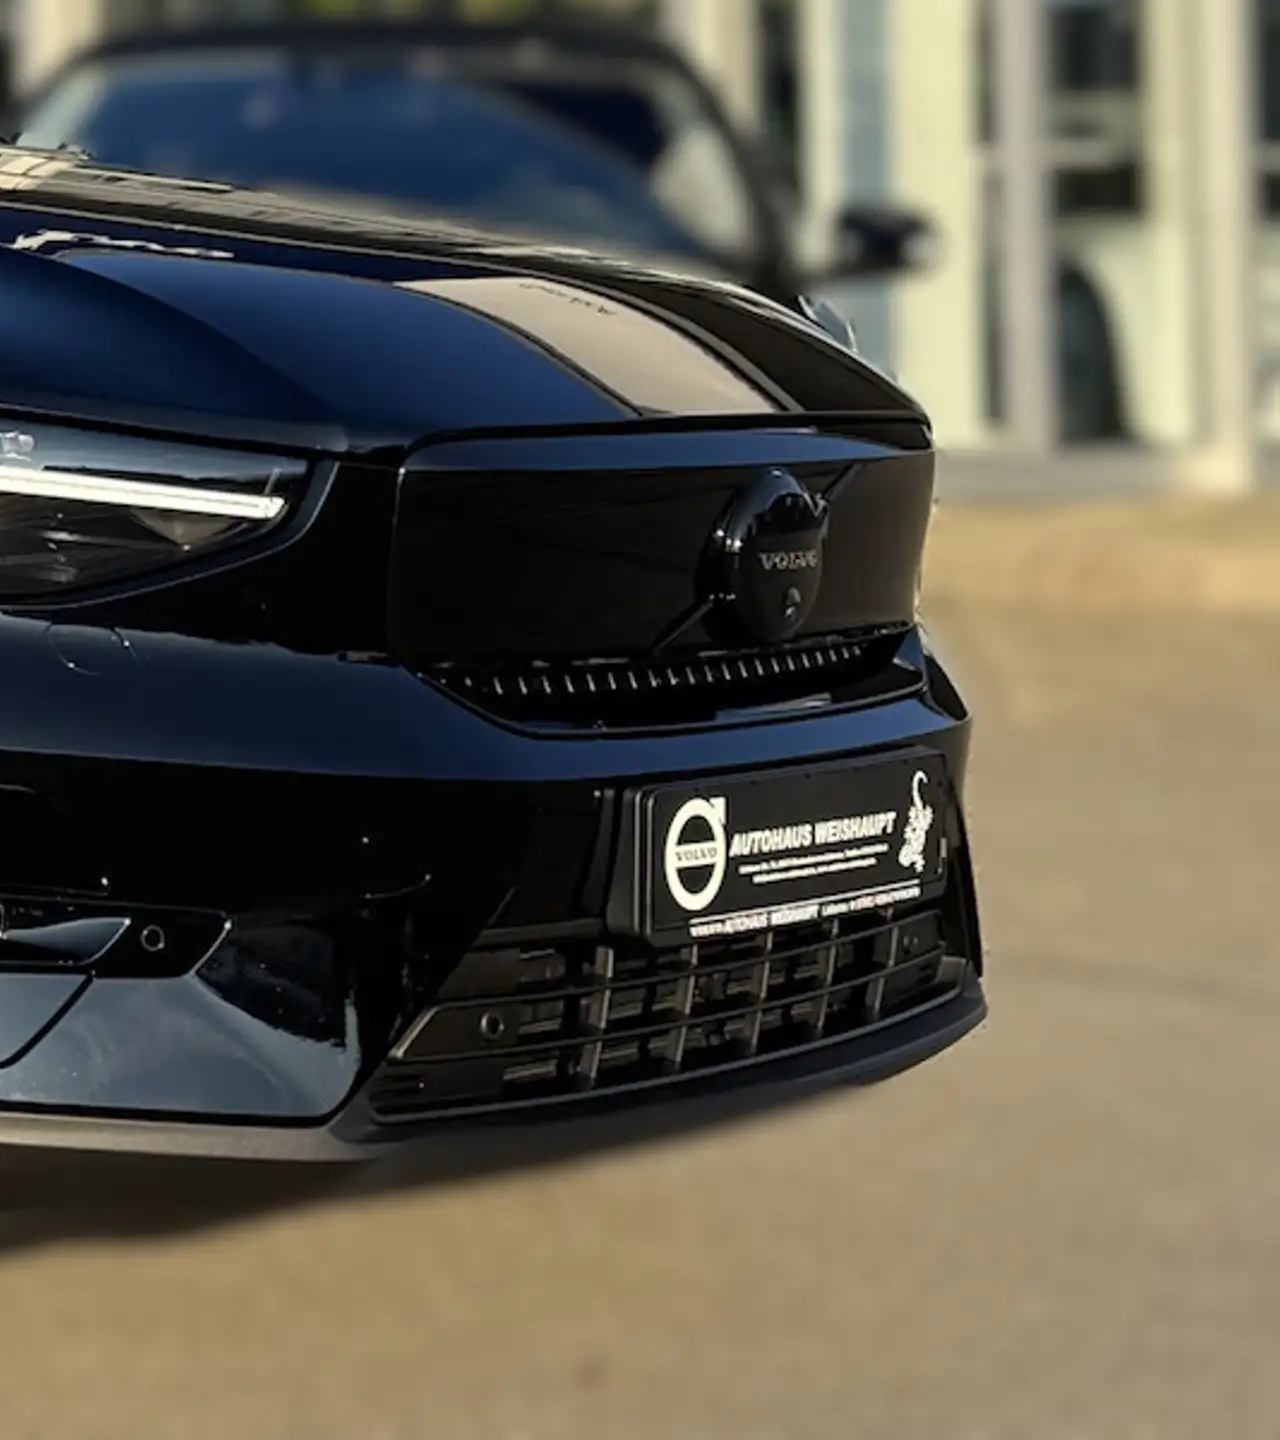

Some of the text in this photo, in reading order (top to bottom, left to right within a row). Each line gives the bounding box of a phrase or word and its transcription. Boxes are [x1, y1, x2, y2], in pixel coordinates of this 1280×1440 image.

[759, 550, 818, 570] VOLVO
[729, 810, 897, 858] AUTOHAUS WEISHAUPT
[675, 846, 718, 862] VOLVO
